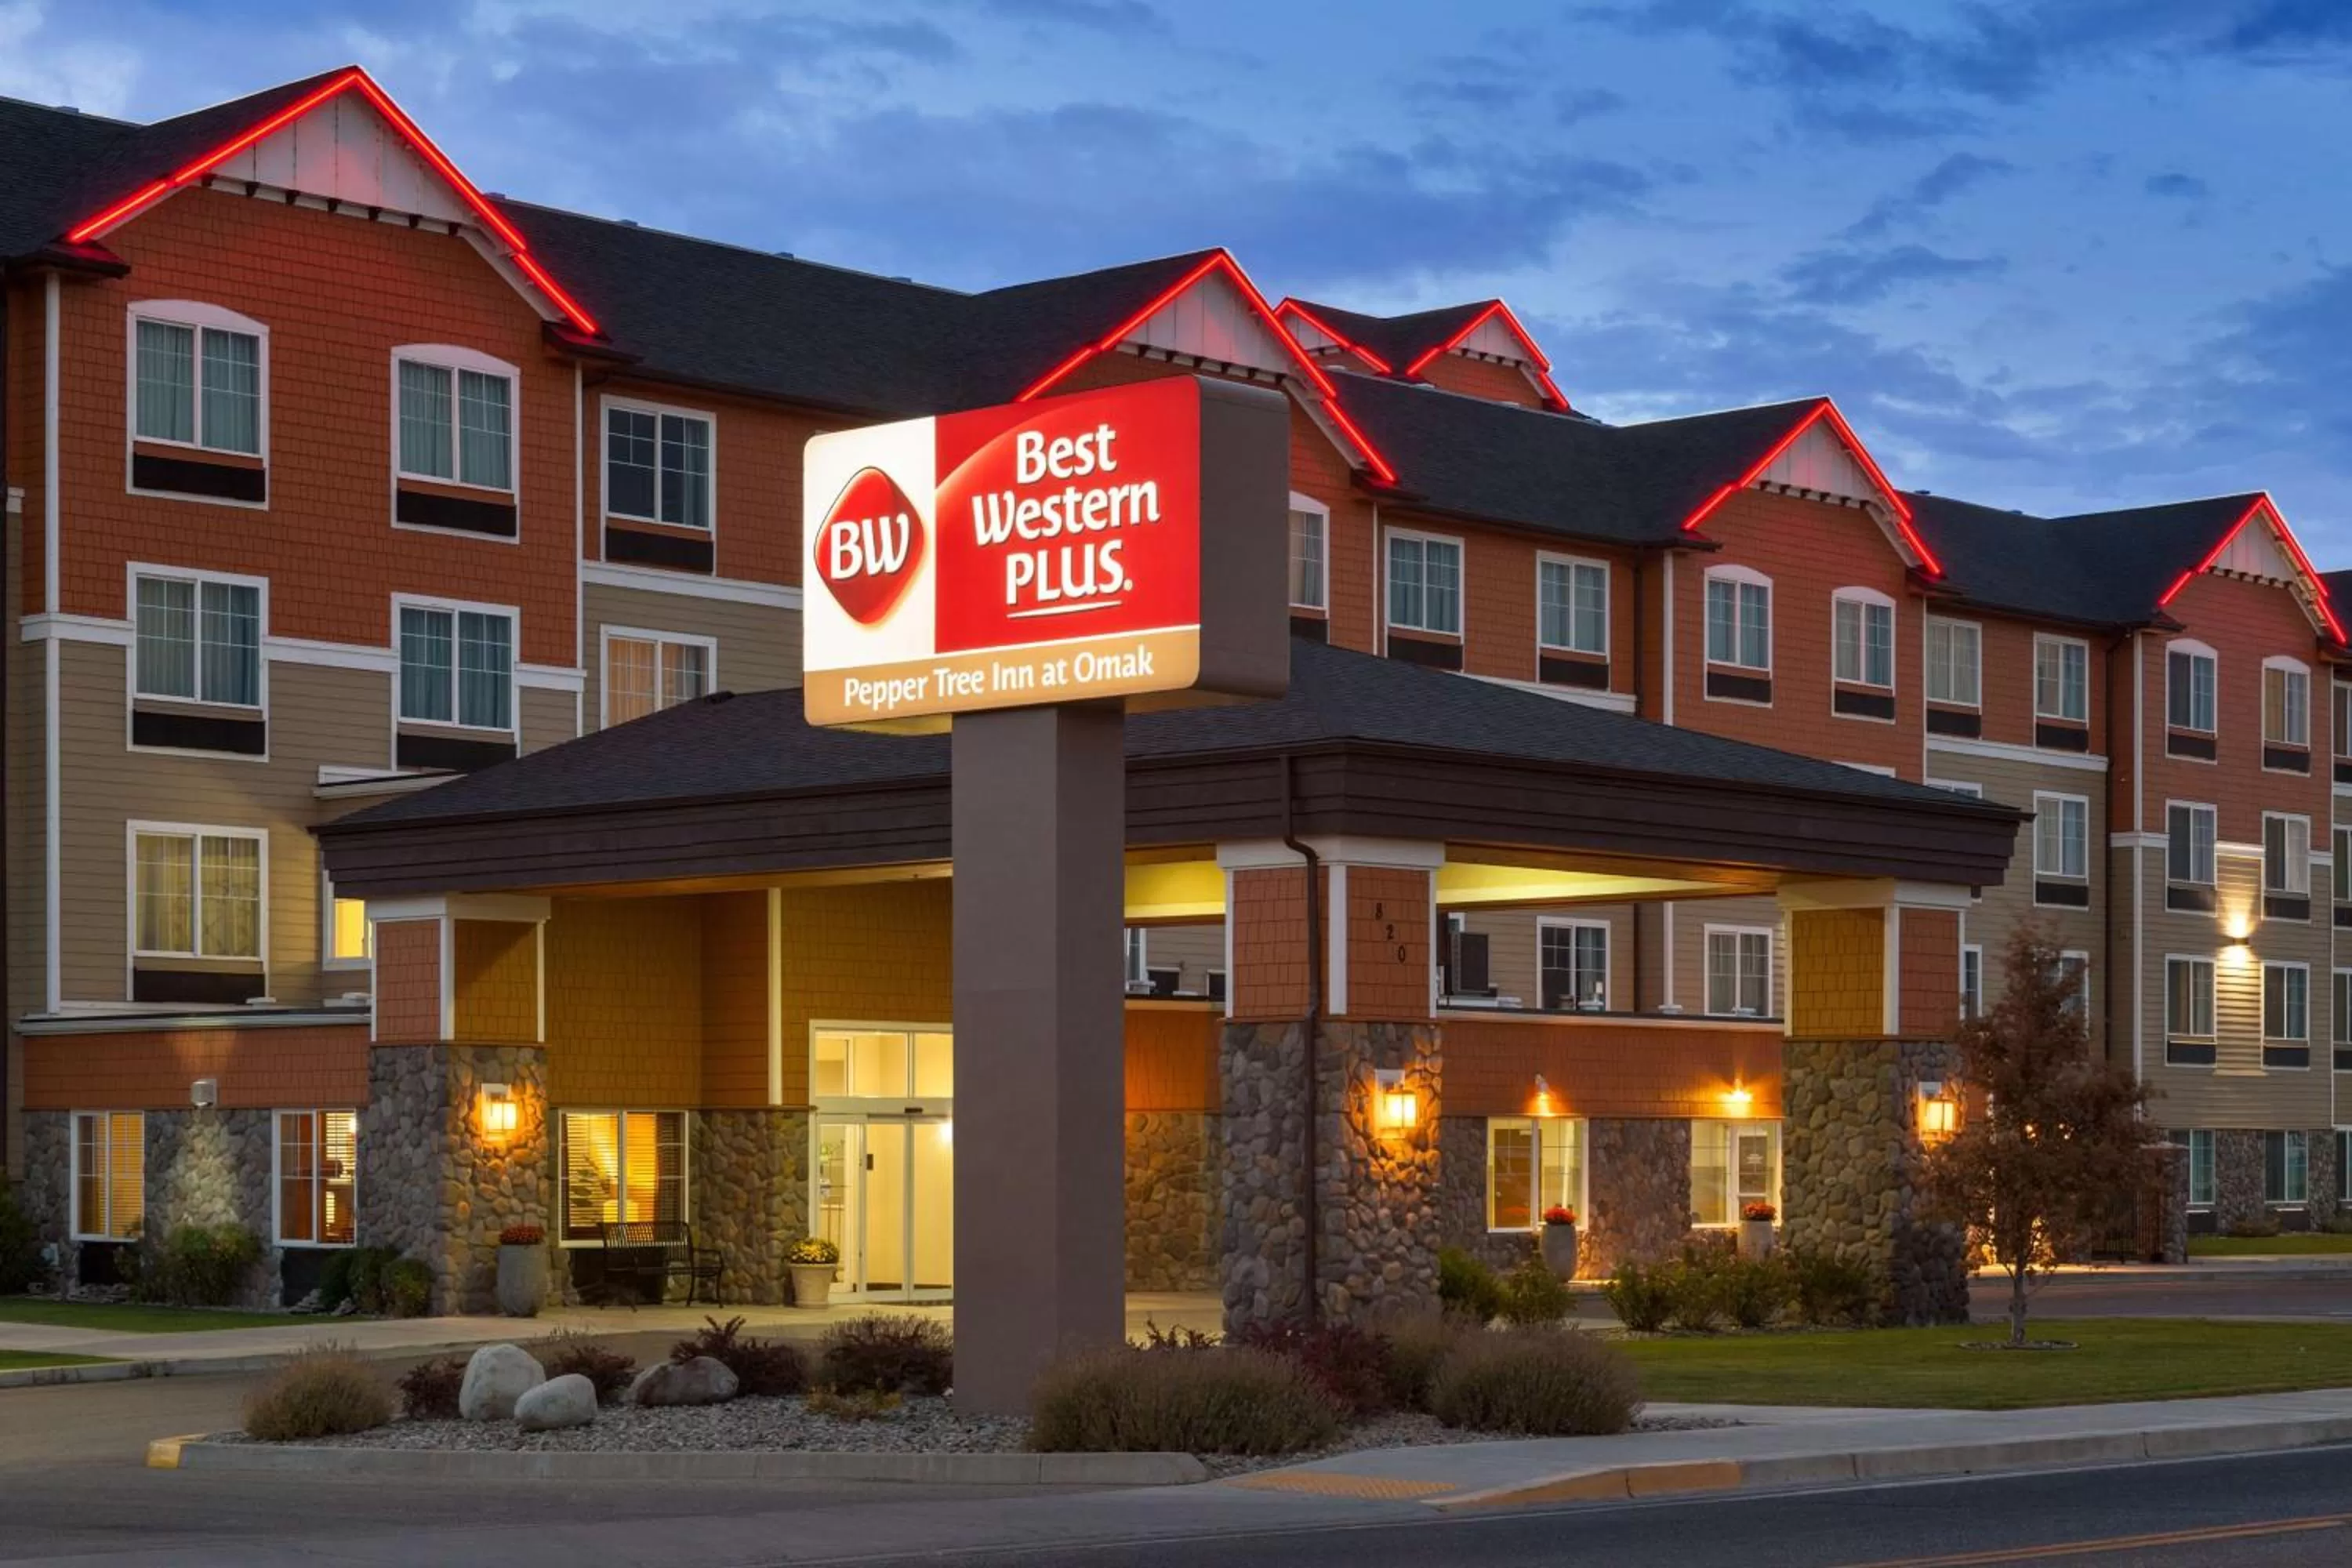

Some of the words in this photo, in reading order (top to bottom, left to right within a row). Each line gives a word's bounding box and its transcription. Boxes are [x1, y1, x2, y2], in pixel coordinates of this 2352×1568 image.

[1016, 423, 1117, 485] Best
[971, 481, 1160, 546] Western
[829, 513, 910, 581] BW
[844, 675, 928, 711] Pepper
[933, 666, 985, 697] Tree
[992, 662, 1034, 691] Inn
[1041, 658, 1068, 686] at
[1073, 644, 1154, 683] Omak
